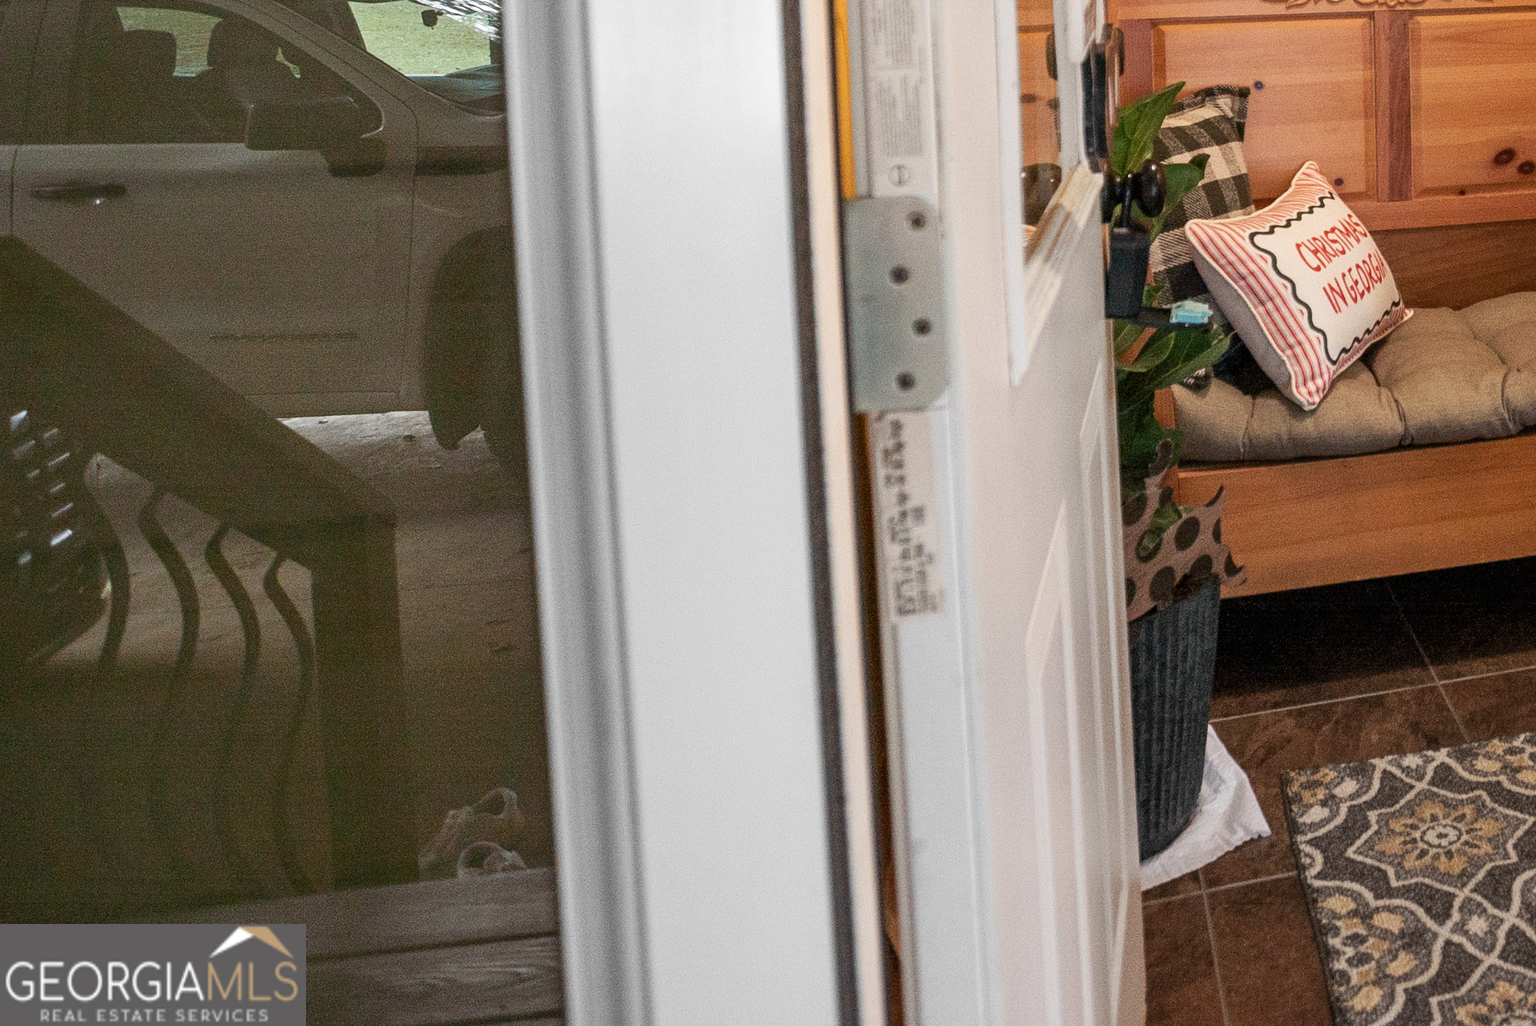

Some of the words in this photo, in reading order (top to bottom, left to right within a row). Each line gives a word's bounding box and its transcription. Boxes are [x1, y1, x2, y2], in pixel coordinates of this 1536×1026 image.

[1295, 213, 1368, 273] CHRISTMAS
[1322, 277, 1348, 314] IN
[1341, 249, 1386, 304] GEORGIA
